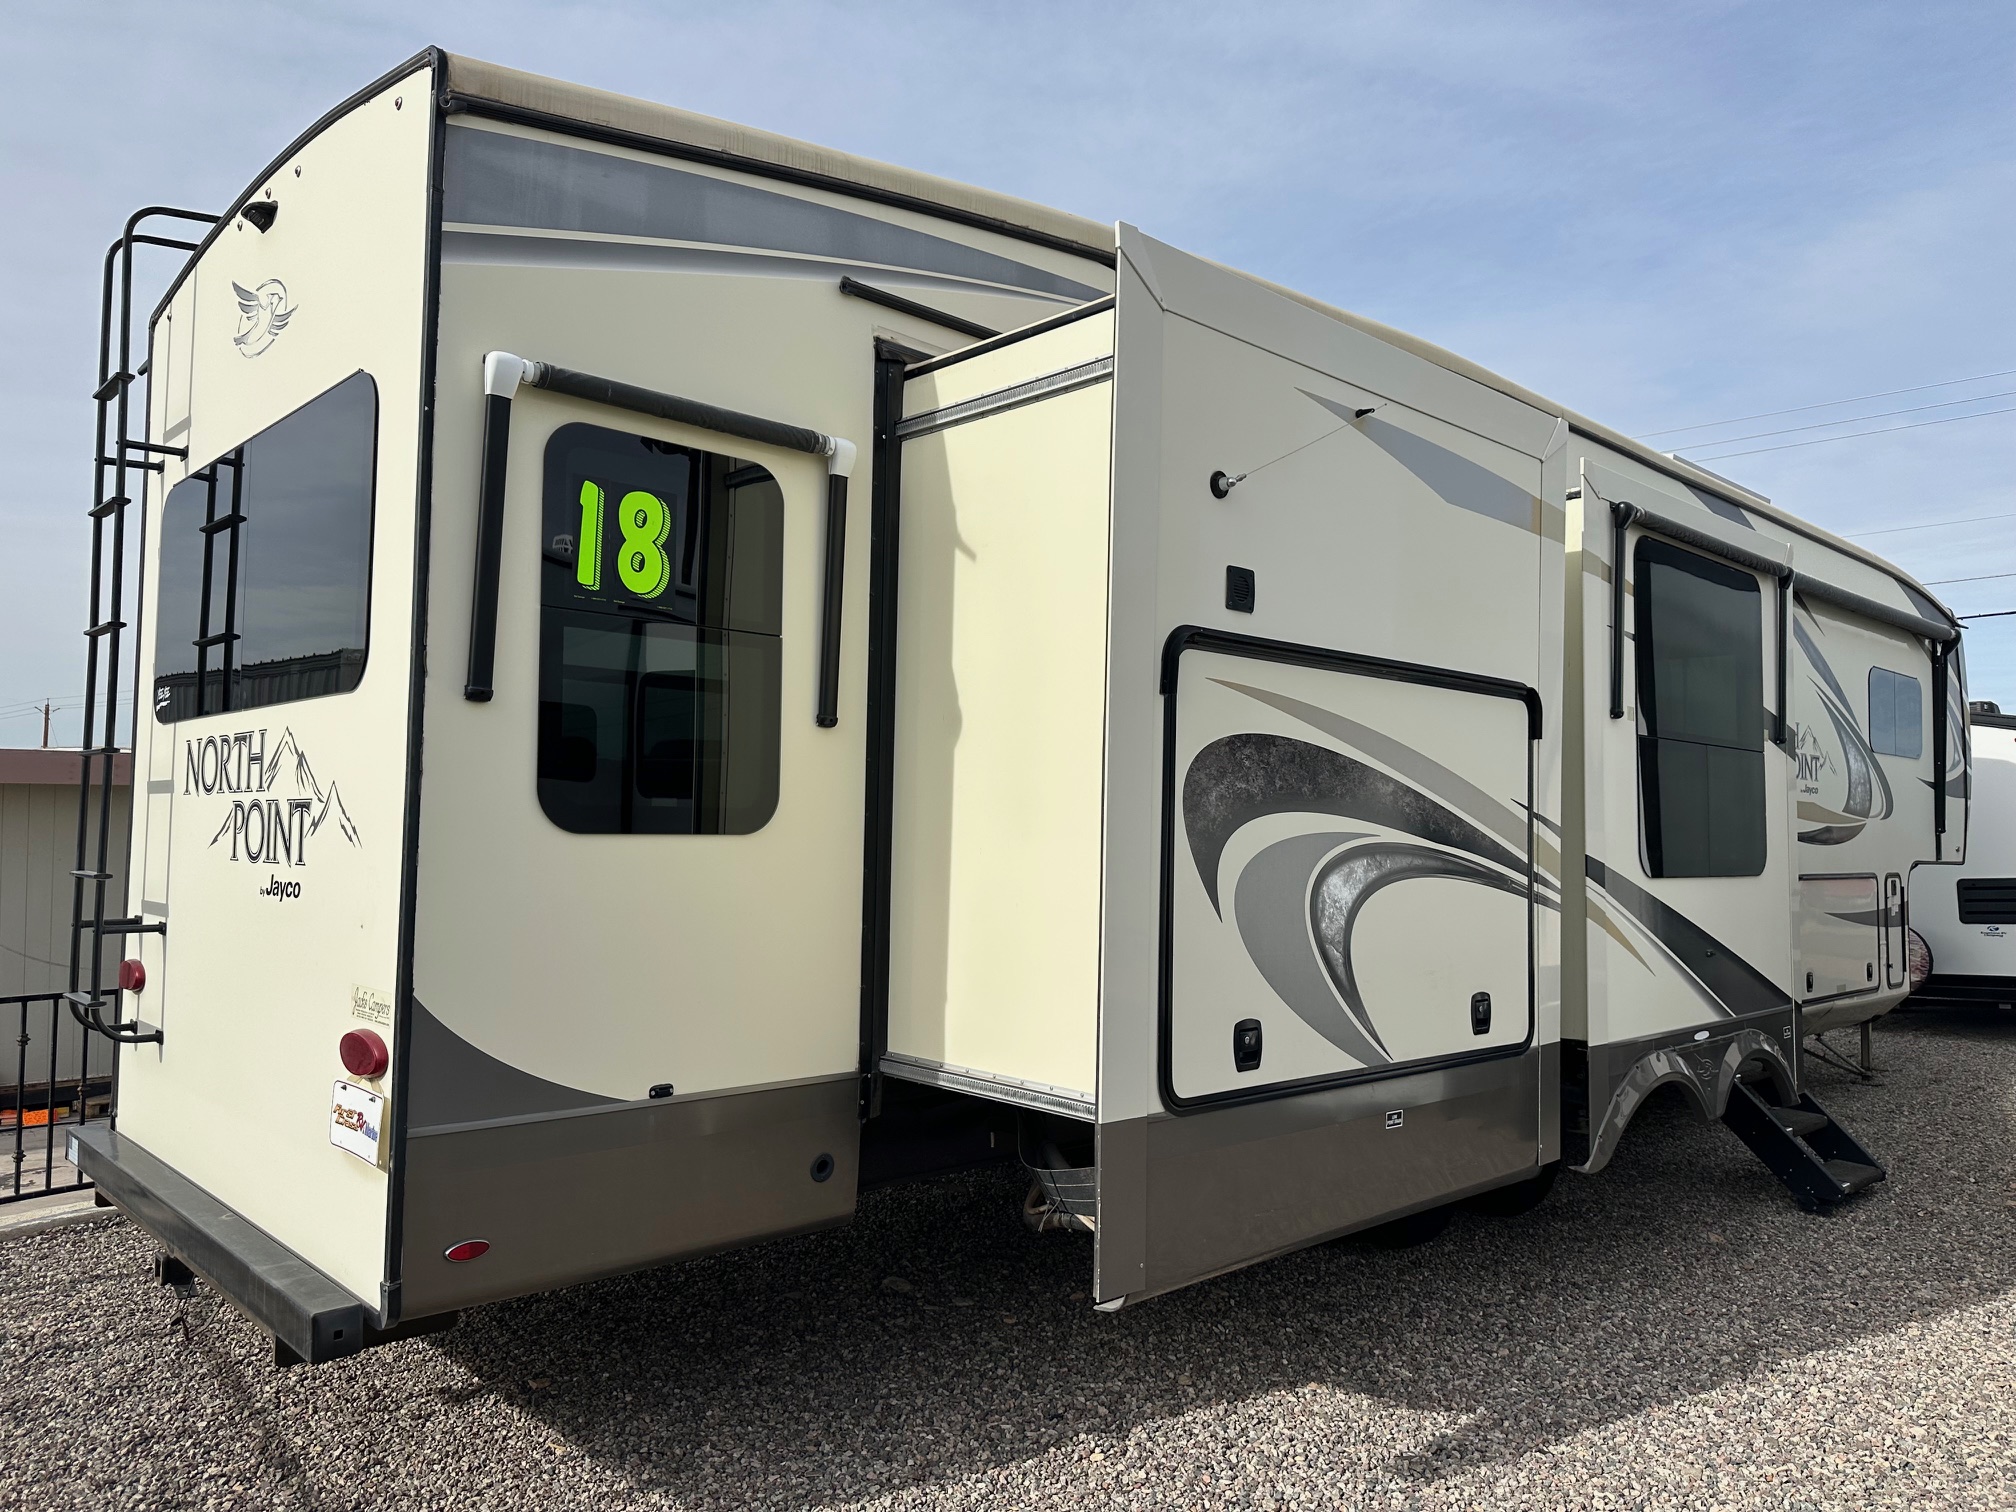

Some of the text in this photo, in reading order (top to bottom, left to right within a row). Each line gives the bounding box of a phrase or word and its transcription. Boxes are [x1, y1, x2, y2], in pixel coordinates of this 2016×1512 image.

[577, 479, 671, 599] 18
[183, 729, 267, 797] NORTH
[230, 798, 313, 868] POINT
[259, 874, 301, 902] by Jayco
